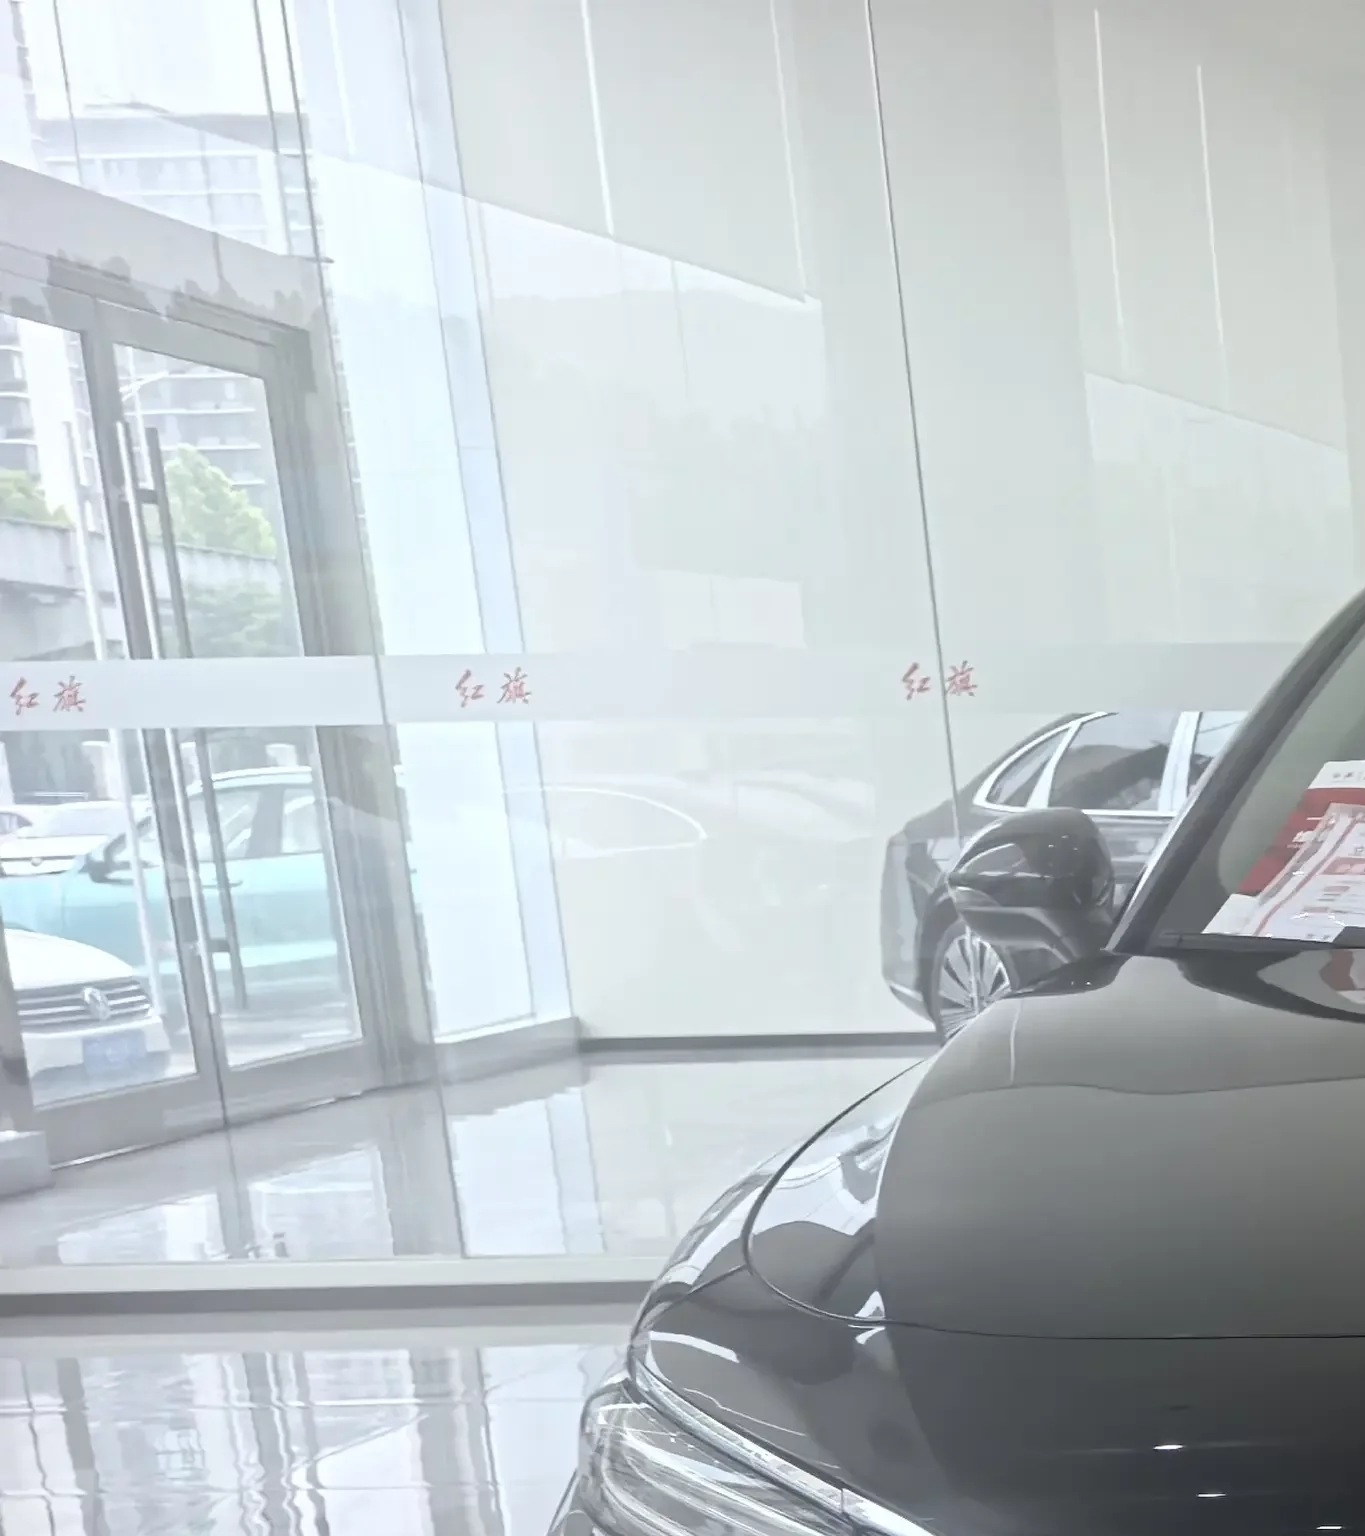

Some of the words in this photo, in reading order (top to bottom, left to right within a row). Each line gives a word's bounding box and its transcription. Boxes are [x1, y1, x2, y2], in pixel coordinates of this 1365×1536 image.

[9, 675, 87, 716] 红旗
[455, 666, 532, 708] 红旗
[901, 660, 978, 701] 红旗
